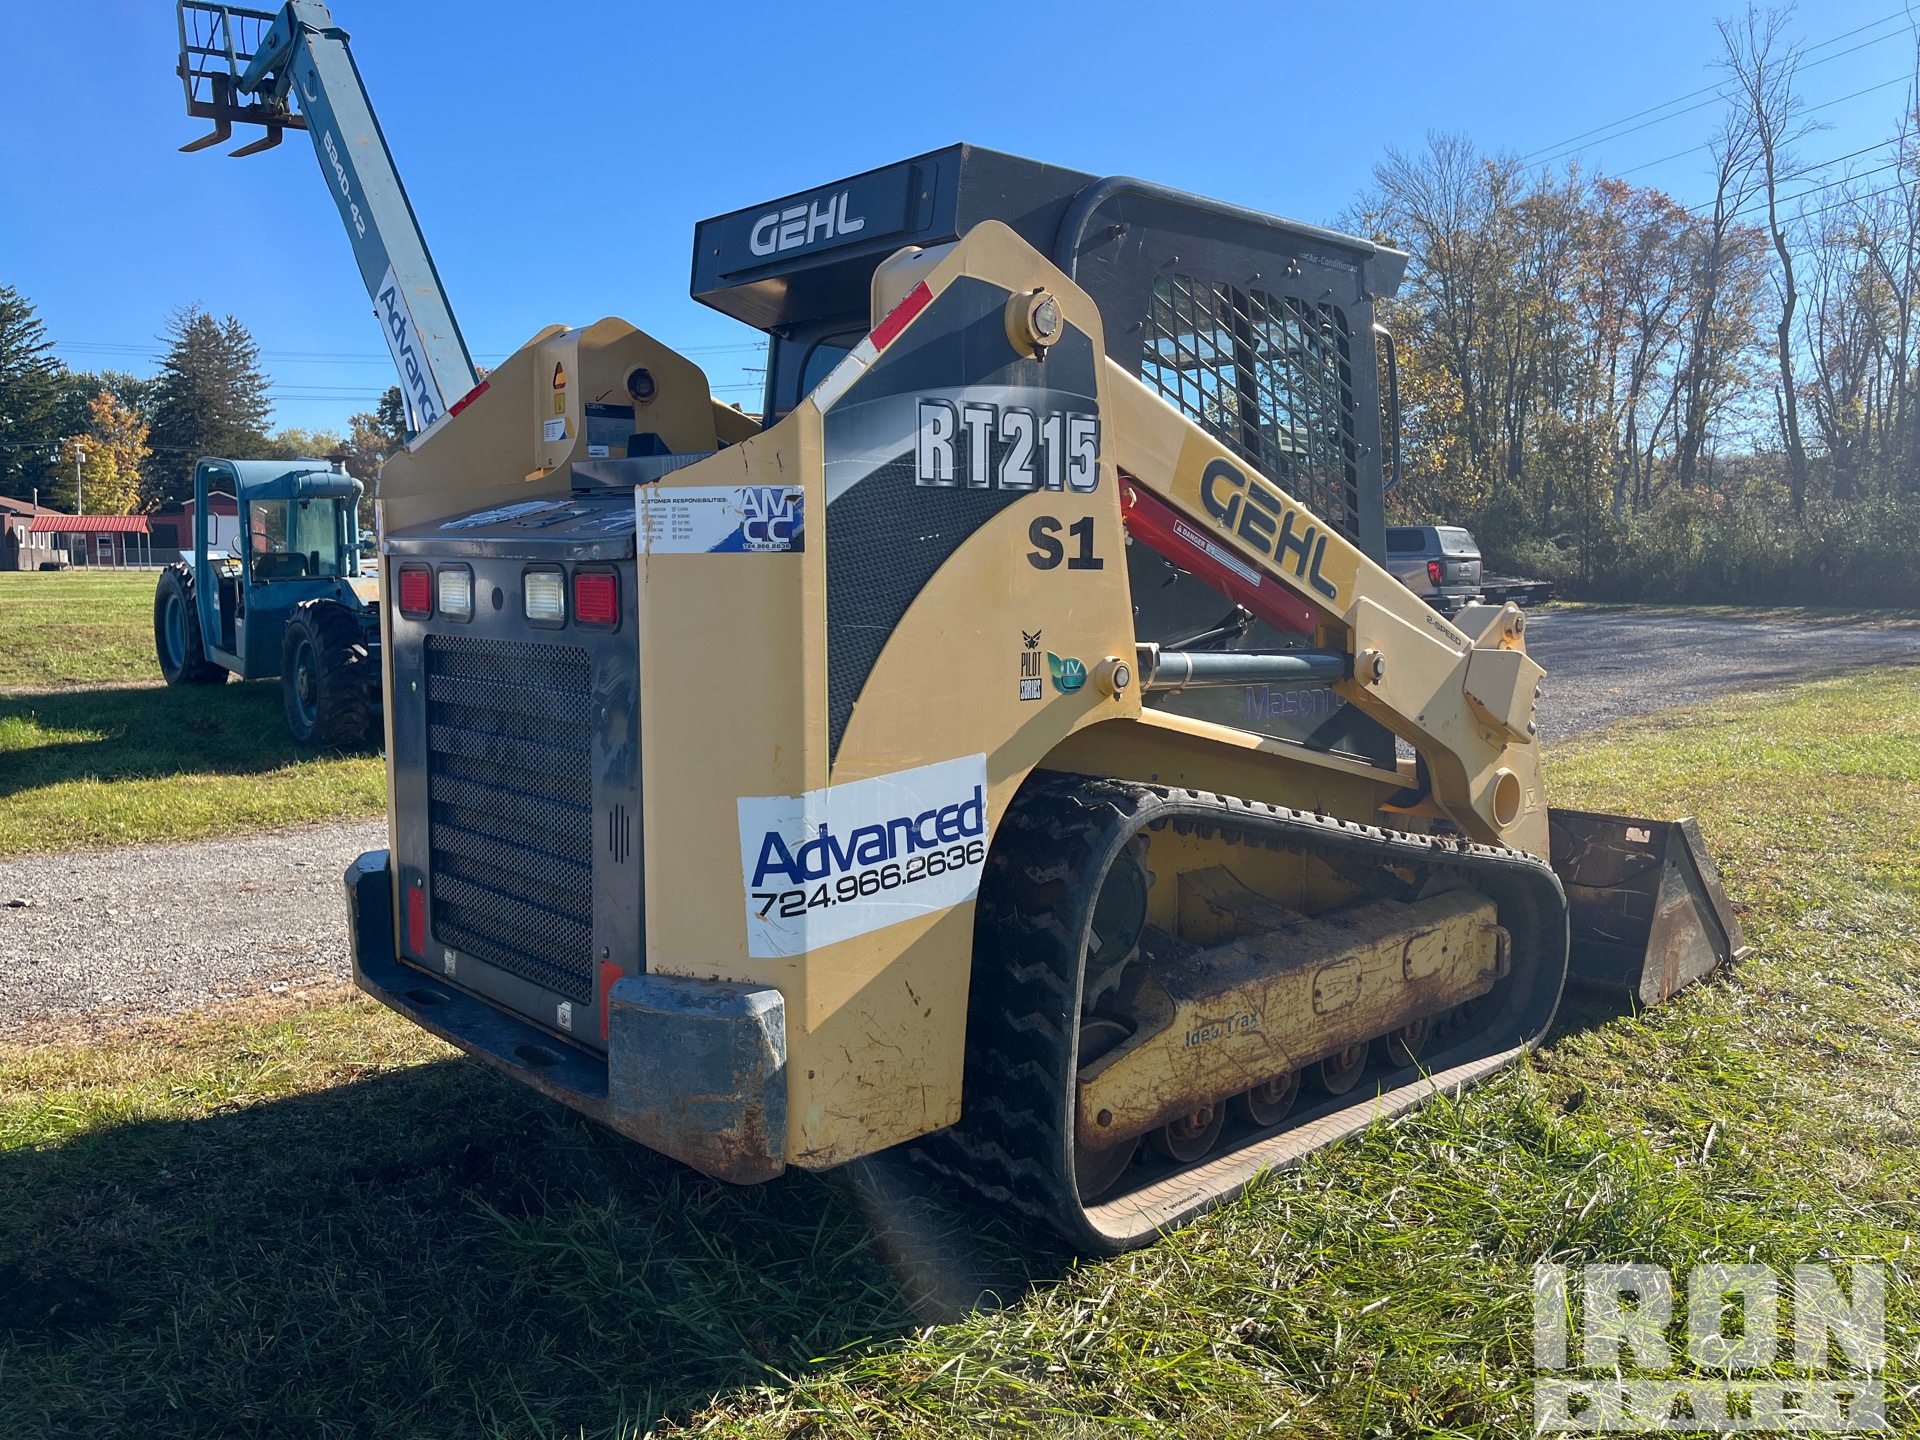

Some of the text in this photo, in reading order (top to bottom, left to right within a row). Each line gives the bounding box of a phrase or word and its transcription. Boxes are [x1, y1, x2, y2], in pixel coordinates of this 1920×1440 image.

[749, 189, 865, 257] GEHL
[914, 396, 1102, 494] RT215
[1026, 515, 1104, 571] S1
[1182, 528, 1206, 549] DANGER
[1199, 456, 1338, 602] GEHL
[1020, 651, 1042, 677] PILOT
[1426, 615, 1462, 646] 2-SPEED
[751, 784, 985, 888] Advanced
[751, 839, 986, 919] 724.966.2636
